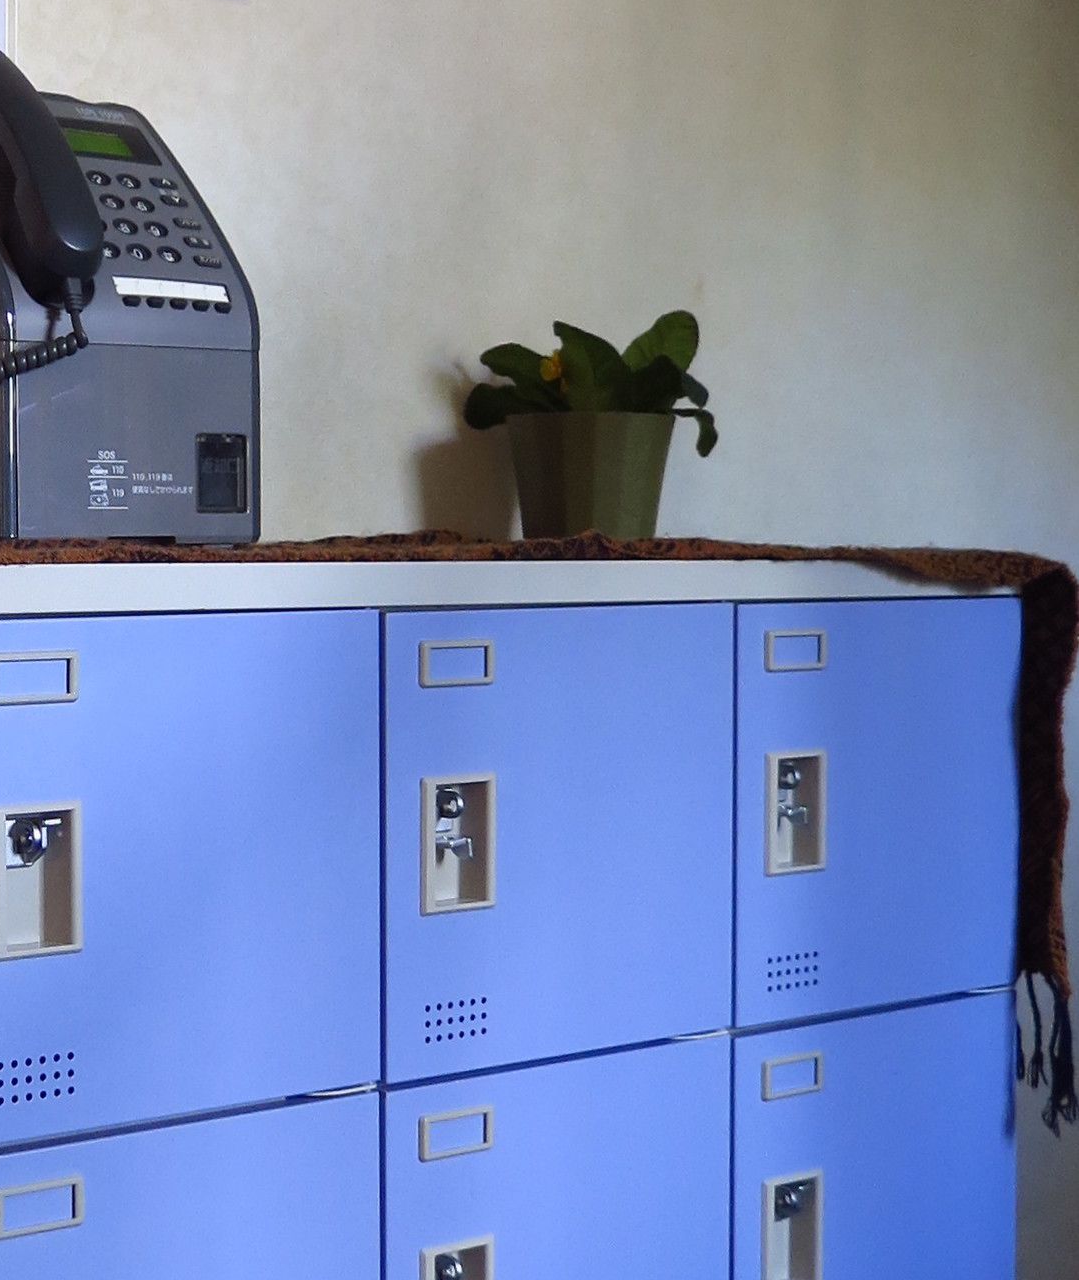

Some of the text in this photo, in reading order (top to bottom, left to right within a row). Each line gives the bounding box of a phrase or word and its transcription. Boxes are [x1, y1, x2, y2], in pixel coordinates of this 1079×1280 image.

[98, 450, 115, 460] SOS
[112, 465, 124, 475] 110
[112, 488, 125, 498] 119
